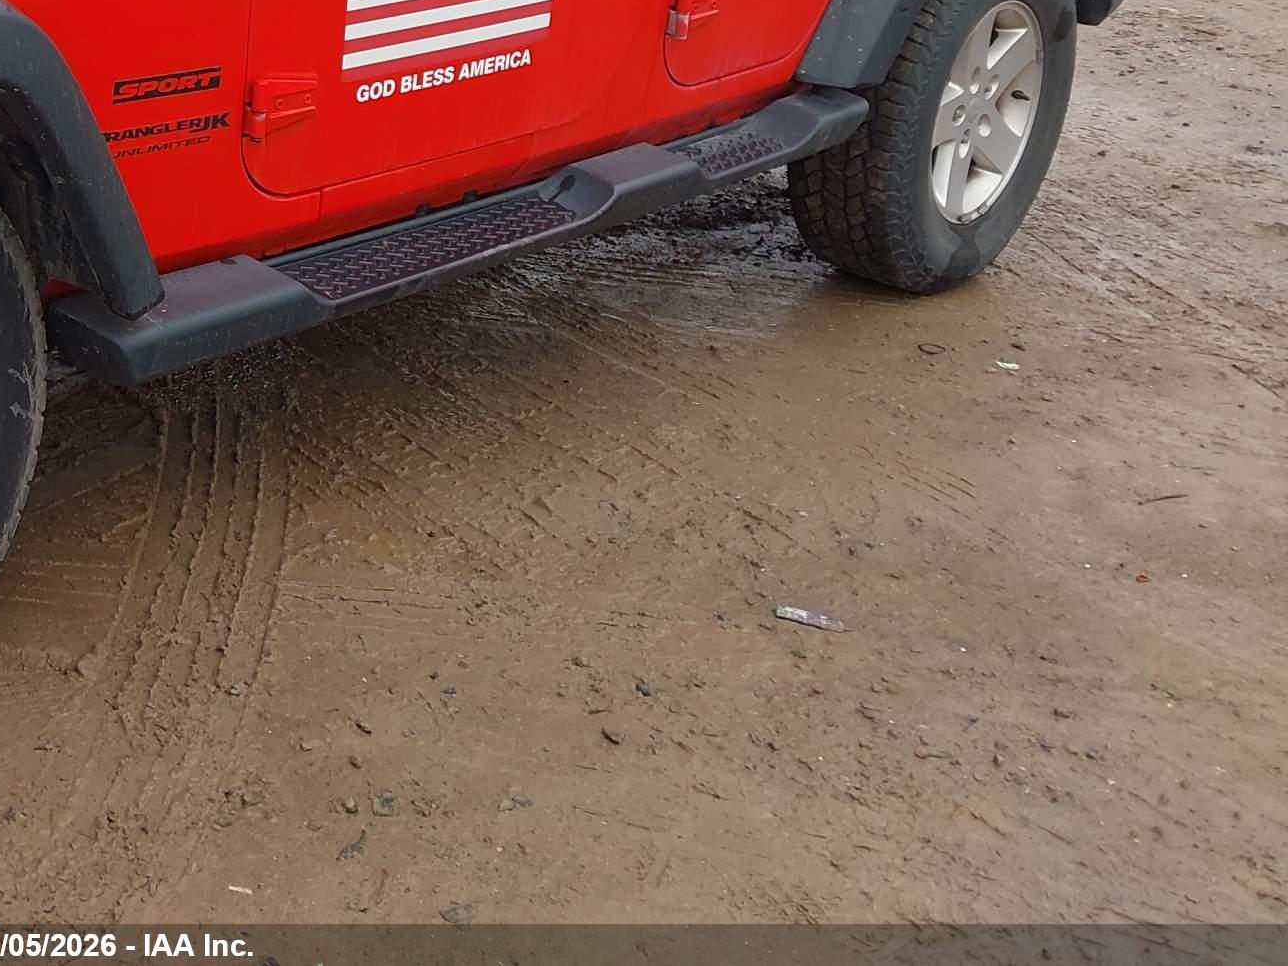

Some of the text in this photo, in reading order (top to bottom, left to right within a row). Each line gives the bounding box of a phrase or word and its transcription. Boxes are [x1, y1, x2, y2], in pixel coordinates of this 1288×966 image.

[114, 71, 221, 101] SPORT
[356, 49, 532, 103] GOD BLESS AMERICA
